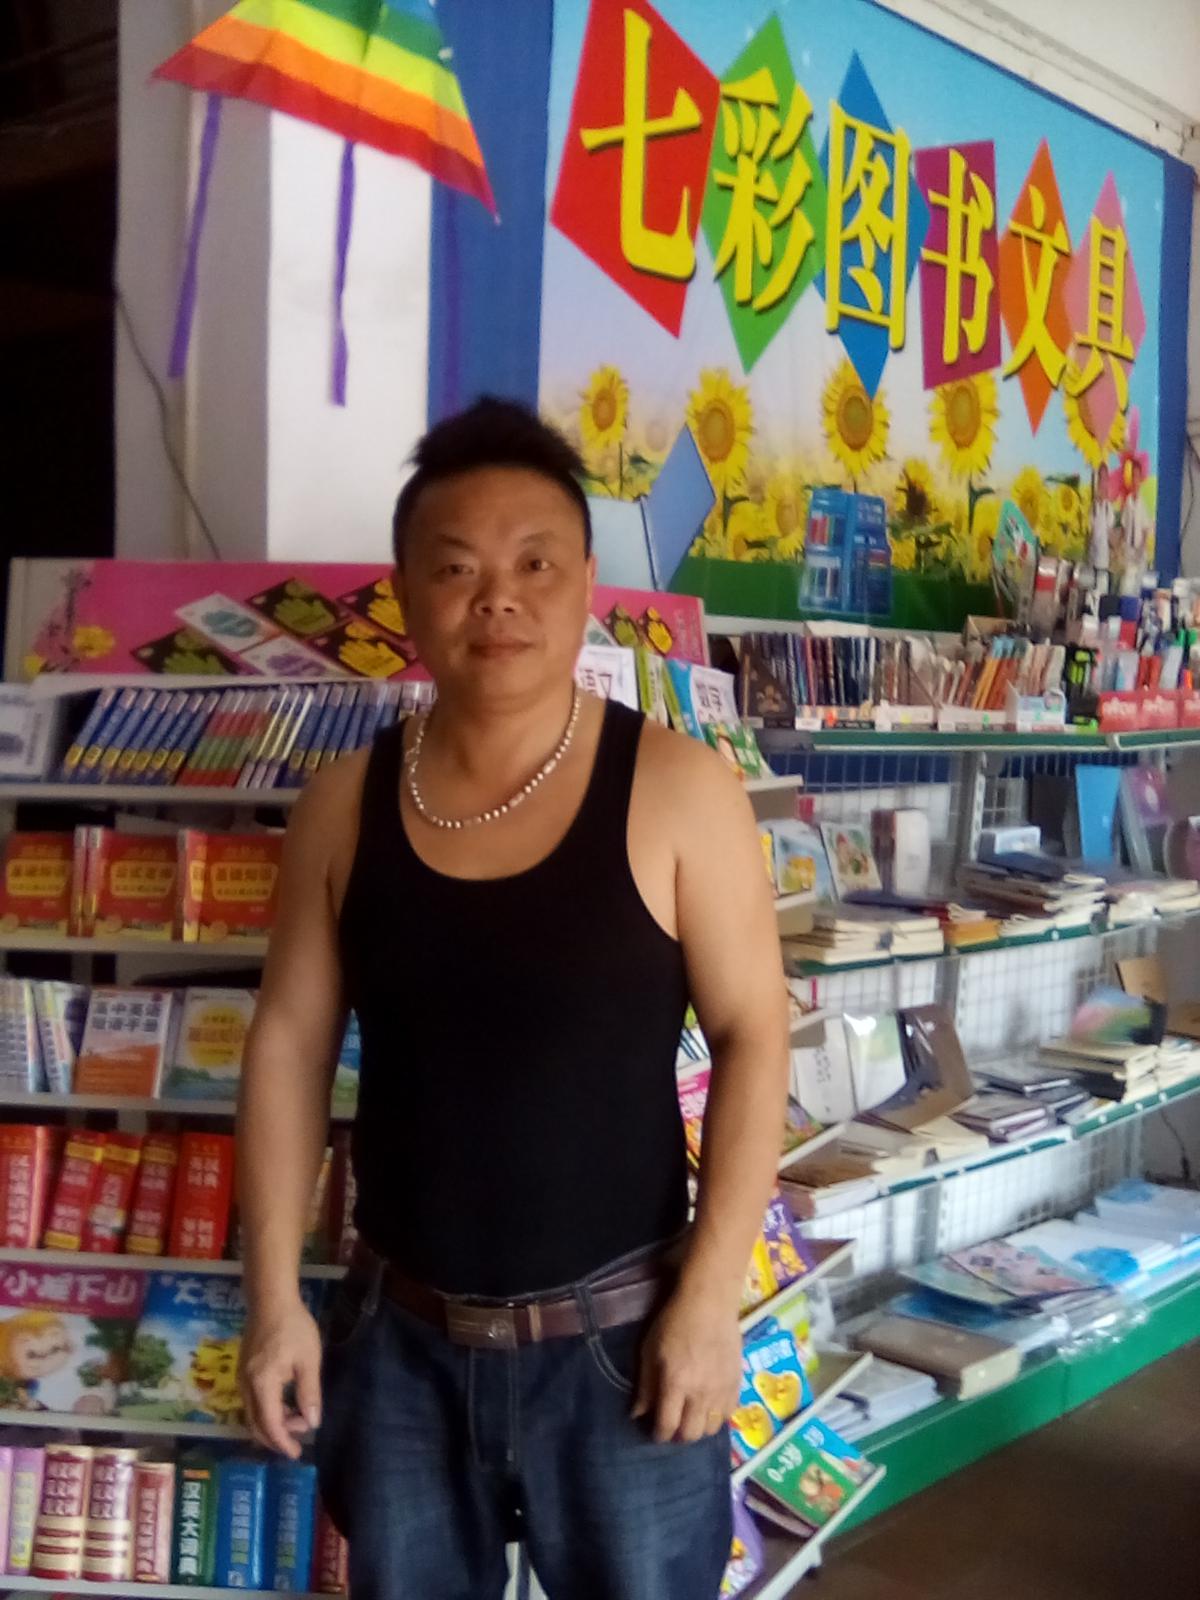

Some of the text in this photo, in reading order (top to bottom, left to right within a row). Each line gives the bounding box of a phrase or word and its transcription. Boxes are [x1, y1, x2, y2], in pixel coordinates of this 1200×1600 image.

[578, 6, 1137, 413] 七彩图书文具
